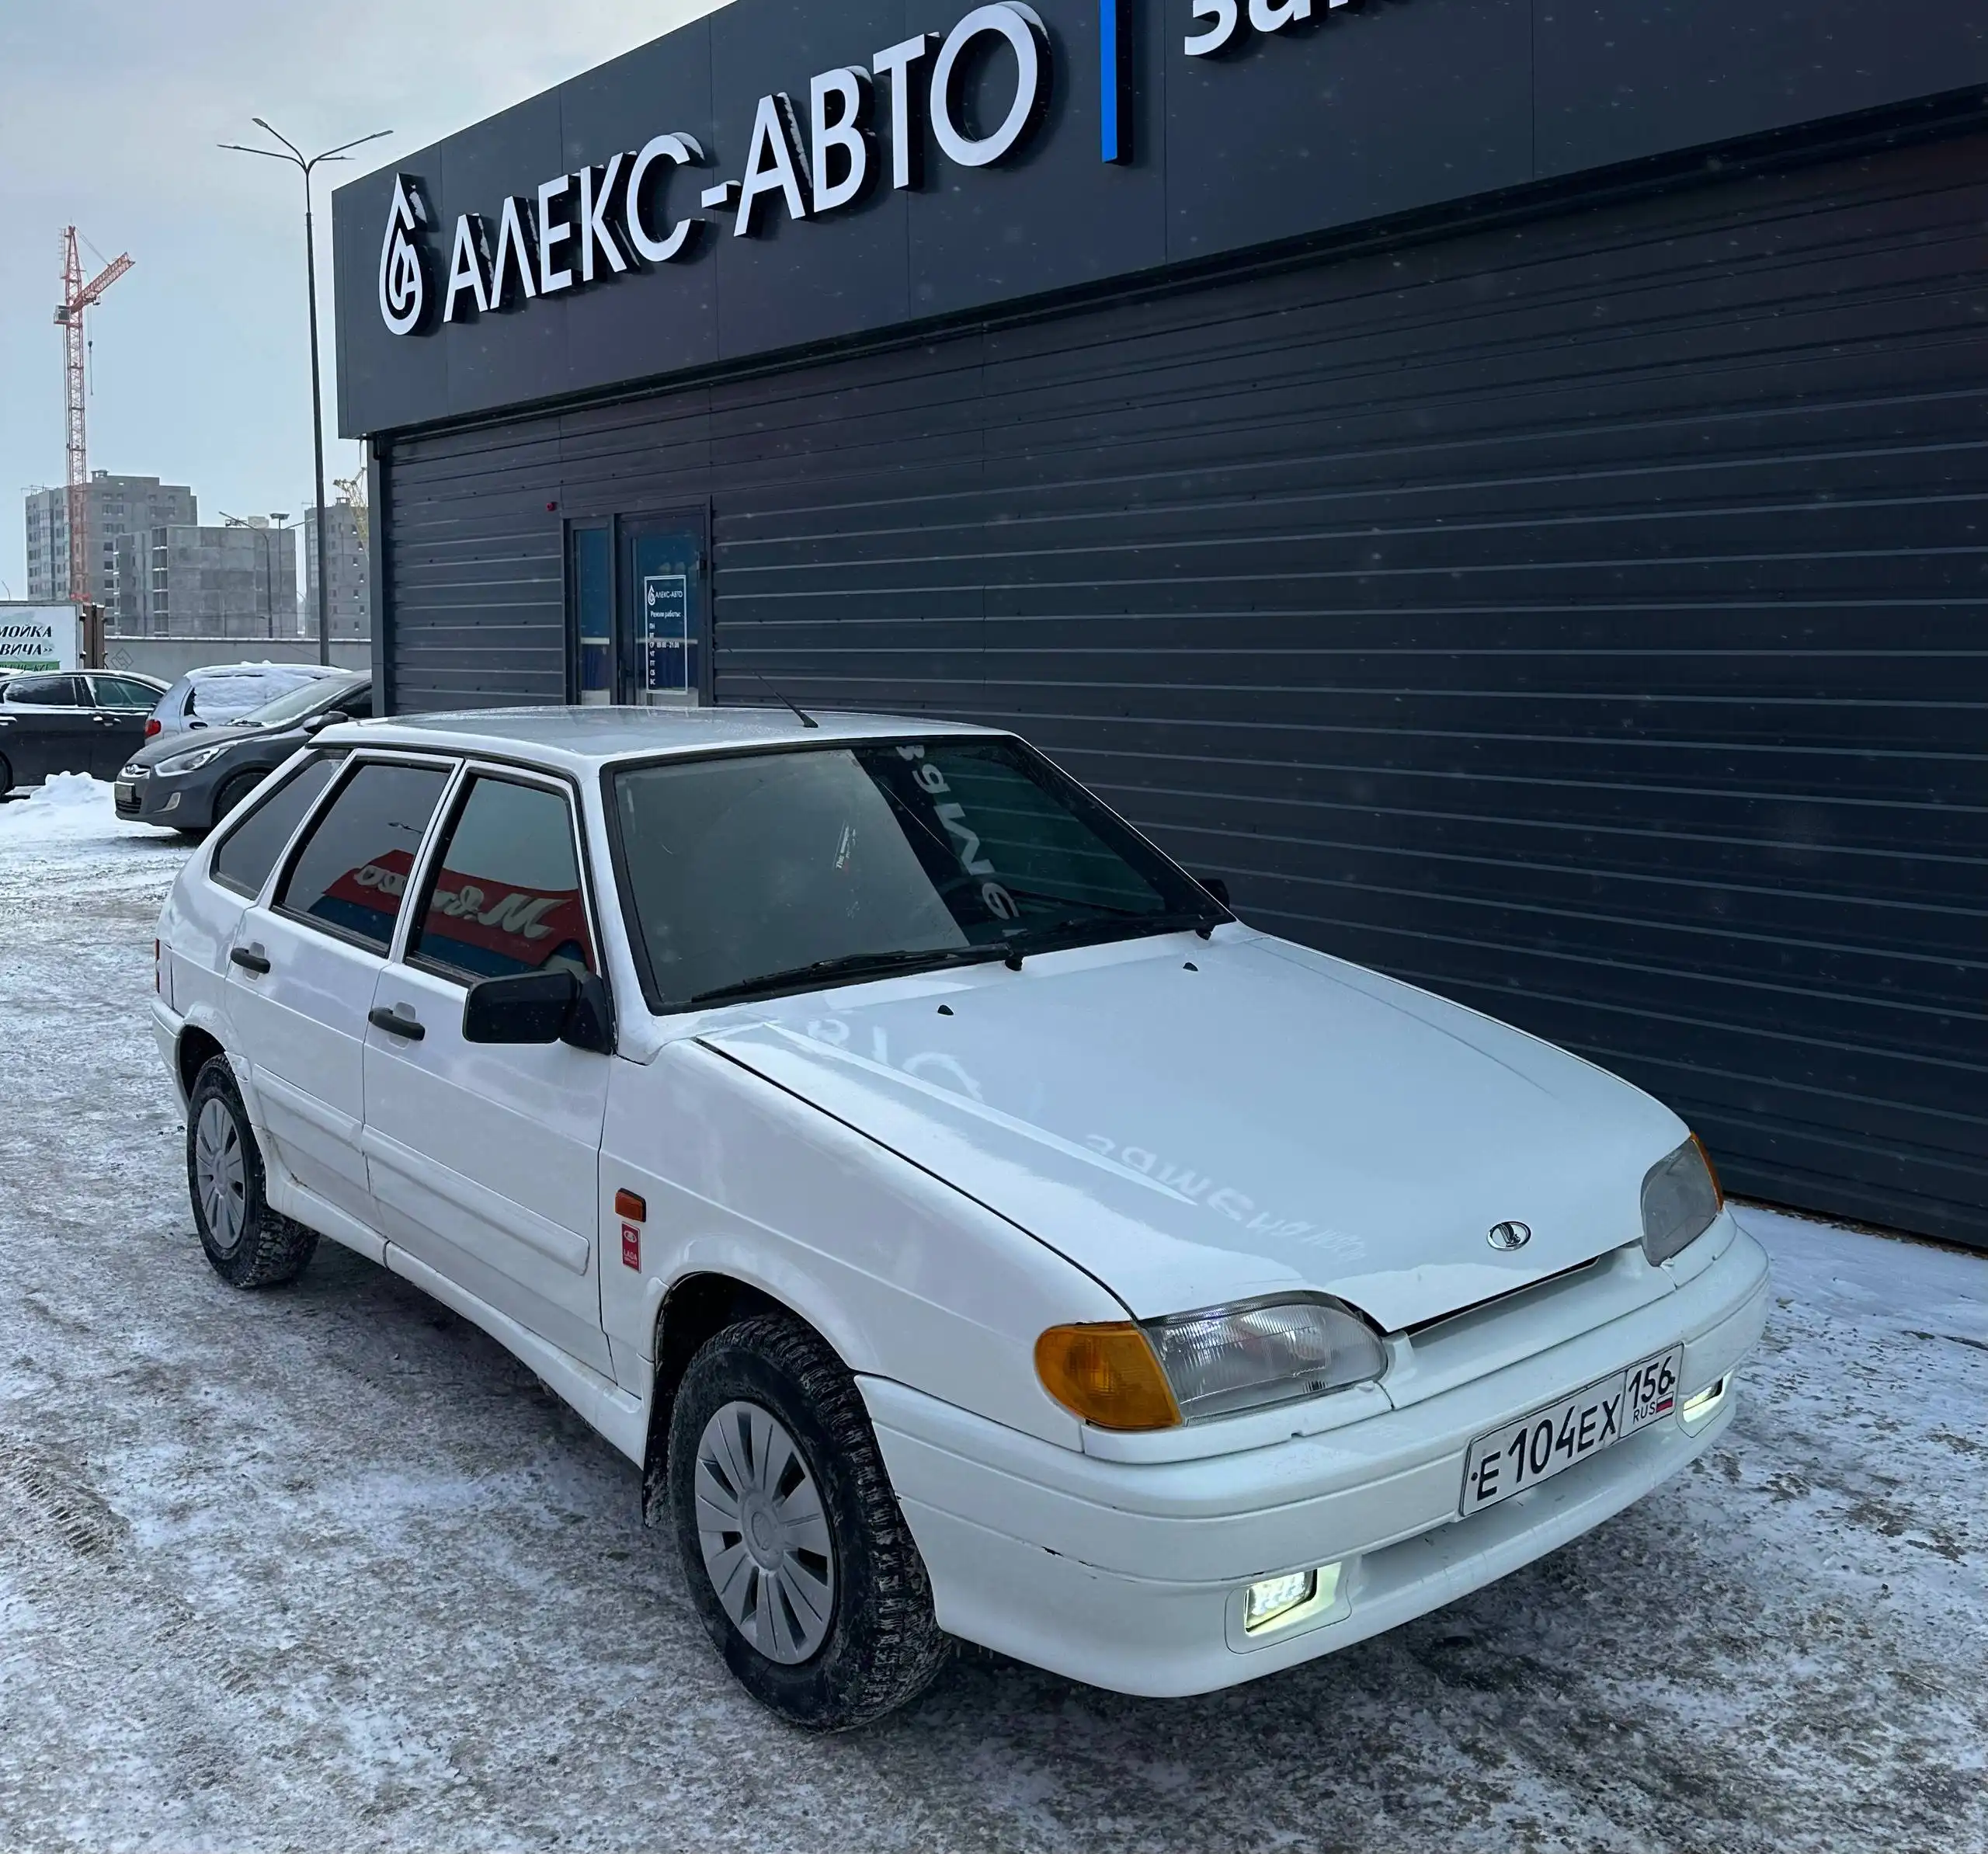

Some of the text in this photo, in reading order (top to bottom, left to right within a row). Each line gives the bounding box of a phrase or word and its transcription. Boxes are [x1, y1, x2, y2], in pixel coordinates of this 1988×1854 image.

[443, 4, 1039, 322] АЛЕКС-АВТО
[1628, 1356, 1673, 1409] 156
[1633, 1401, 1656, 1423] RUS
